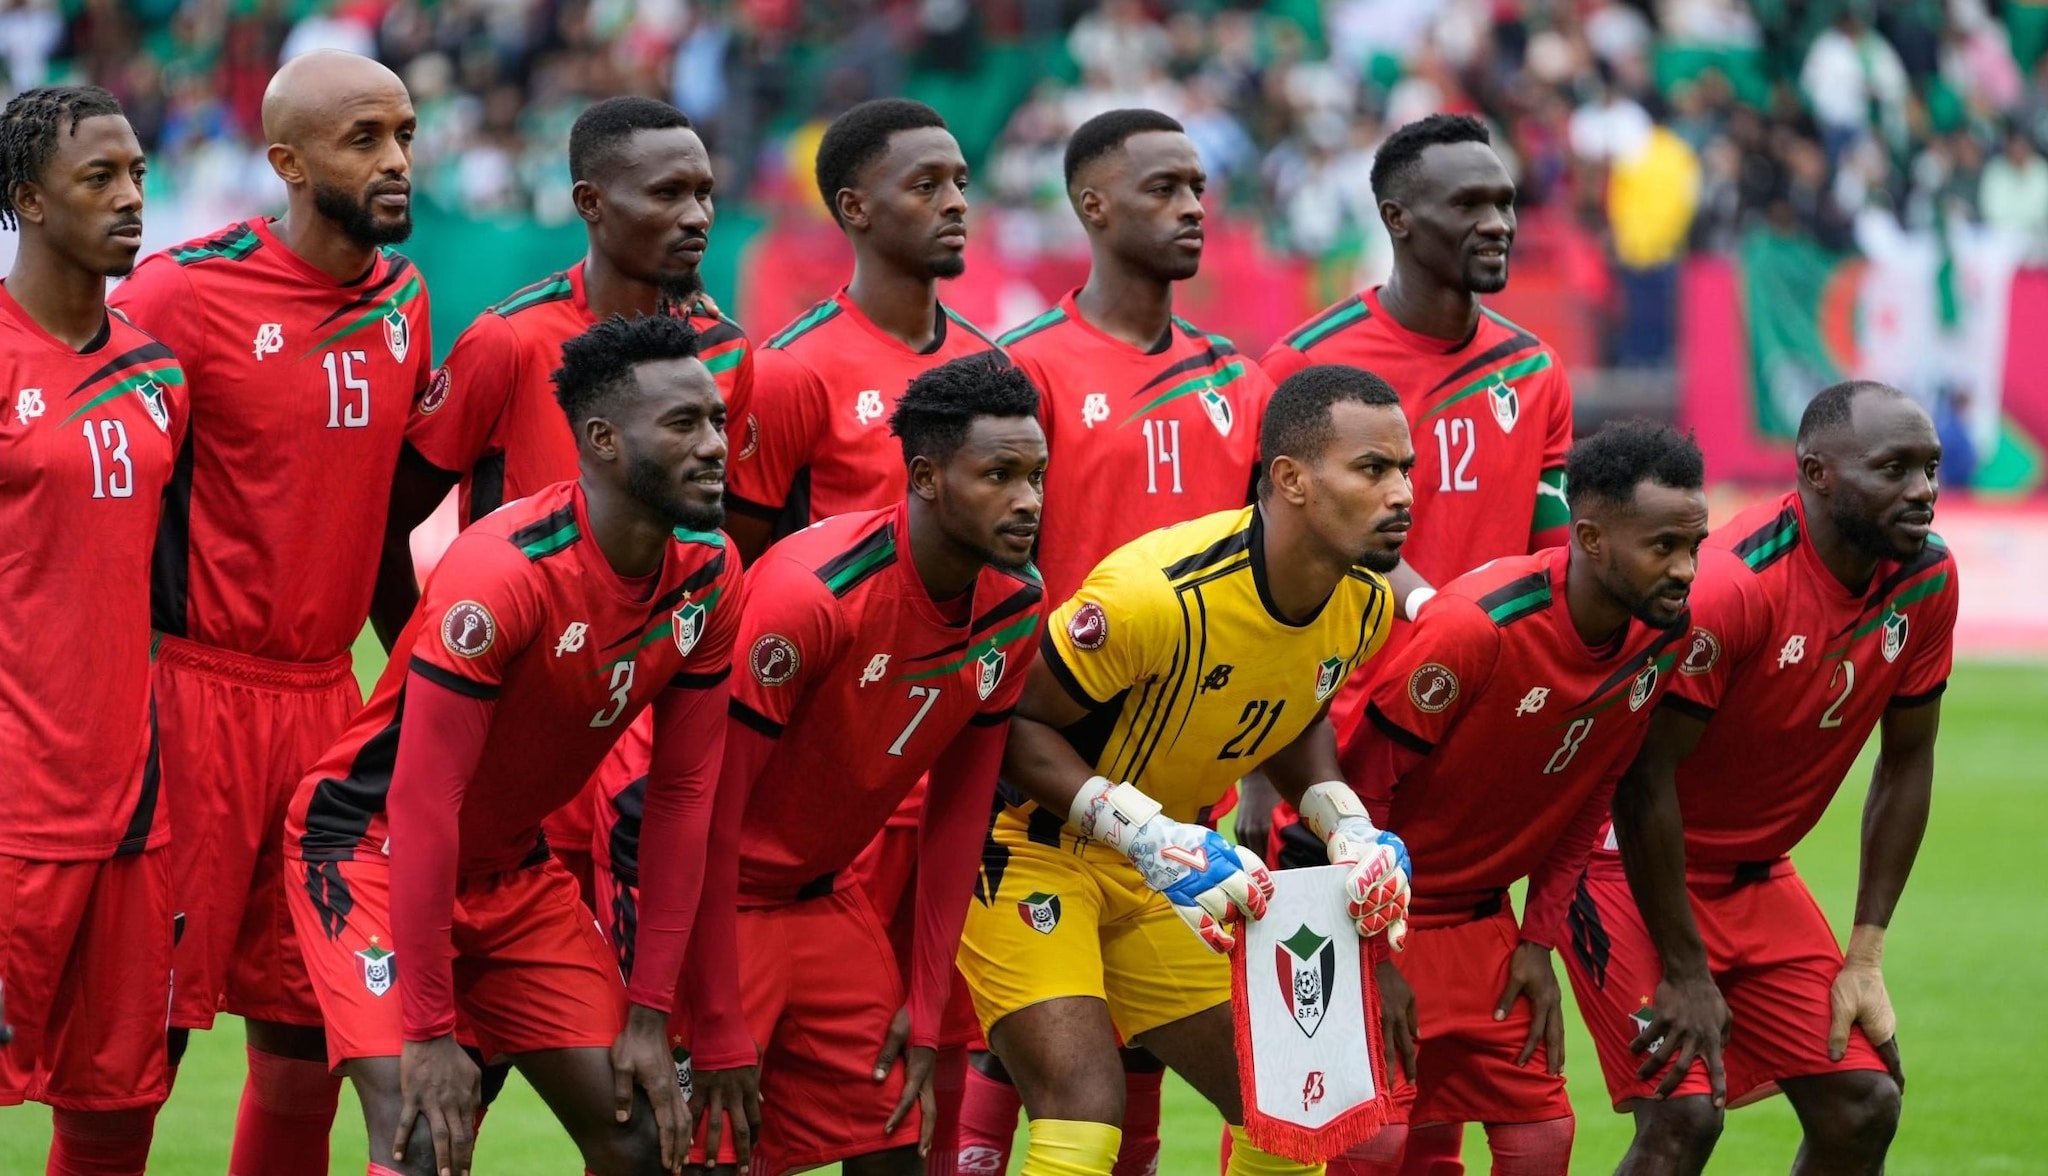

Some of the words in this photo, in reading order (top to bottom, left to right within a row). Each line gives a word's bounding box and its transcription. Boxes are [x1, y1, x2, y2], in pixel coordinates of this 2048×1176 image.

[321, 350, 370, 428] 15
[82, 419, 133, 499] 13
[1142, 419, 1183, 493] 14
[1433, 418, 1478, 492] 12
[589, 660, 635, 728] 3
[887, 686, 941, 756] 7
[1819, 660, 1855, 728] 2
[1216, 699, 1286, 760] 21
[1543, 718, 1594, 774] 8
[1299, 1007, 1319, 1018] S.F.A
